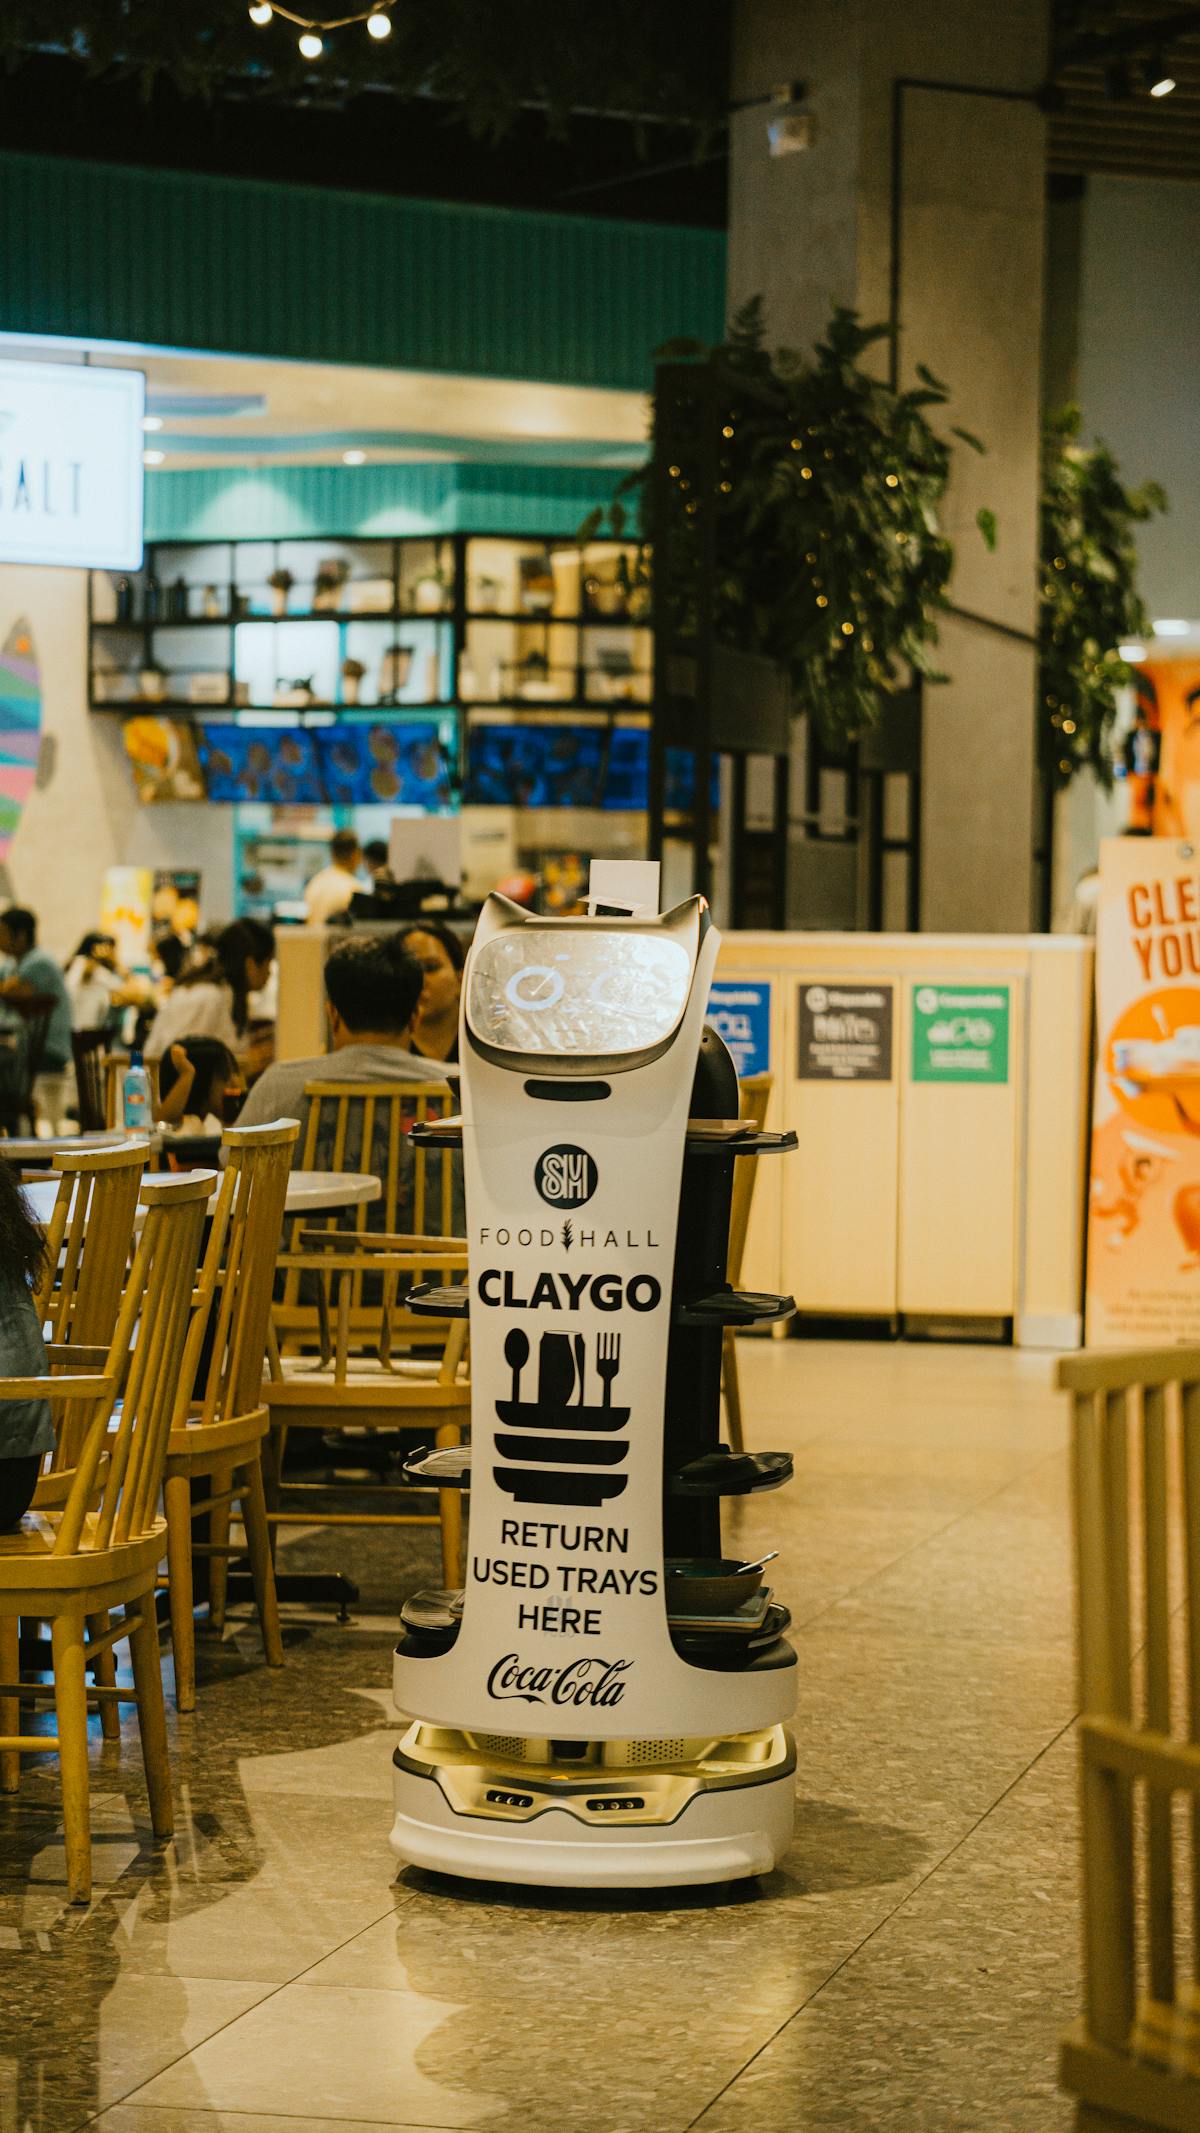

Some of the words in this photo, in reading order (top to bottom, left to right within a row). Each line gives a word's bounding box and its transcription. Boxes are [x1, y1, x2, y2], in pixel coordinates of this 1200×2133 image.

[0, 457, 84, 519] ALT
[1127, 877, 1200, 929] CLE
[479, 1227, 555, 1247] FOOD
[579, 1229, 660, 1248] HALL
[477, 1268, 662, 1313] CLAYGO
[500, 1519, 629, 1553] RETURN
[473, 1556, 550, 1590] USED
[556, 1566, 659, 1596] TRAYS
[517, 1603, 602, 1635] HERE
[486, 1653, 635, 1707] Coca-Cola
